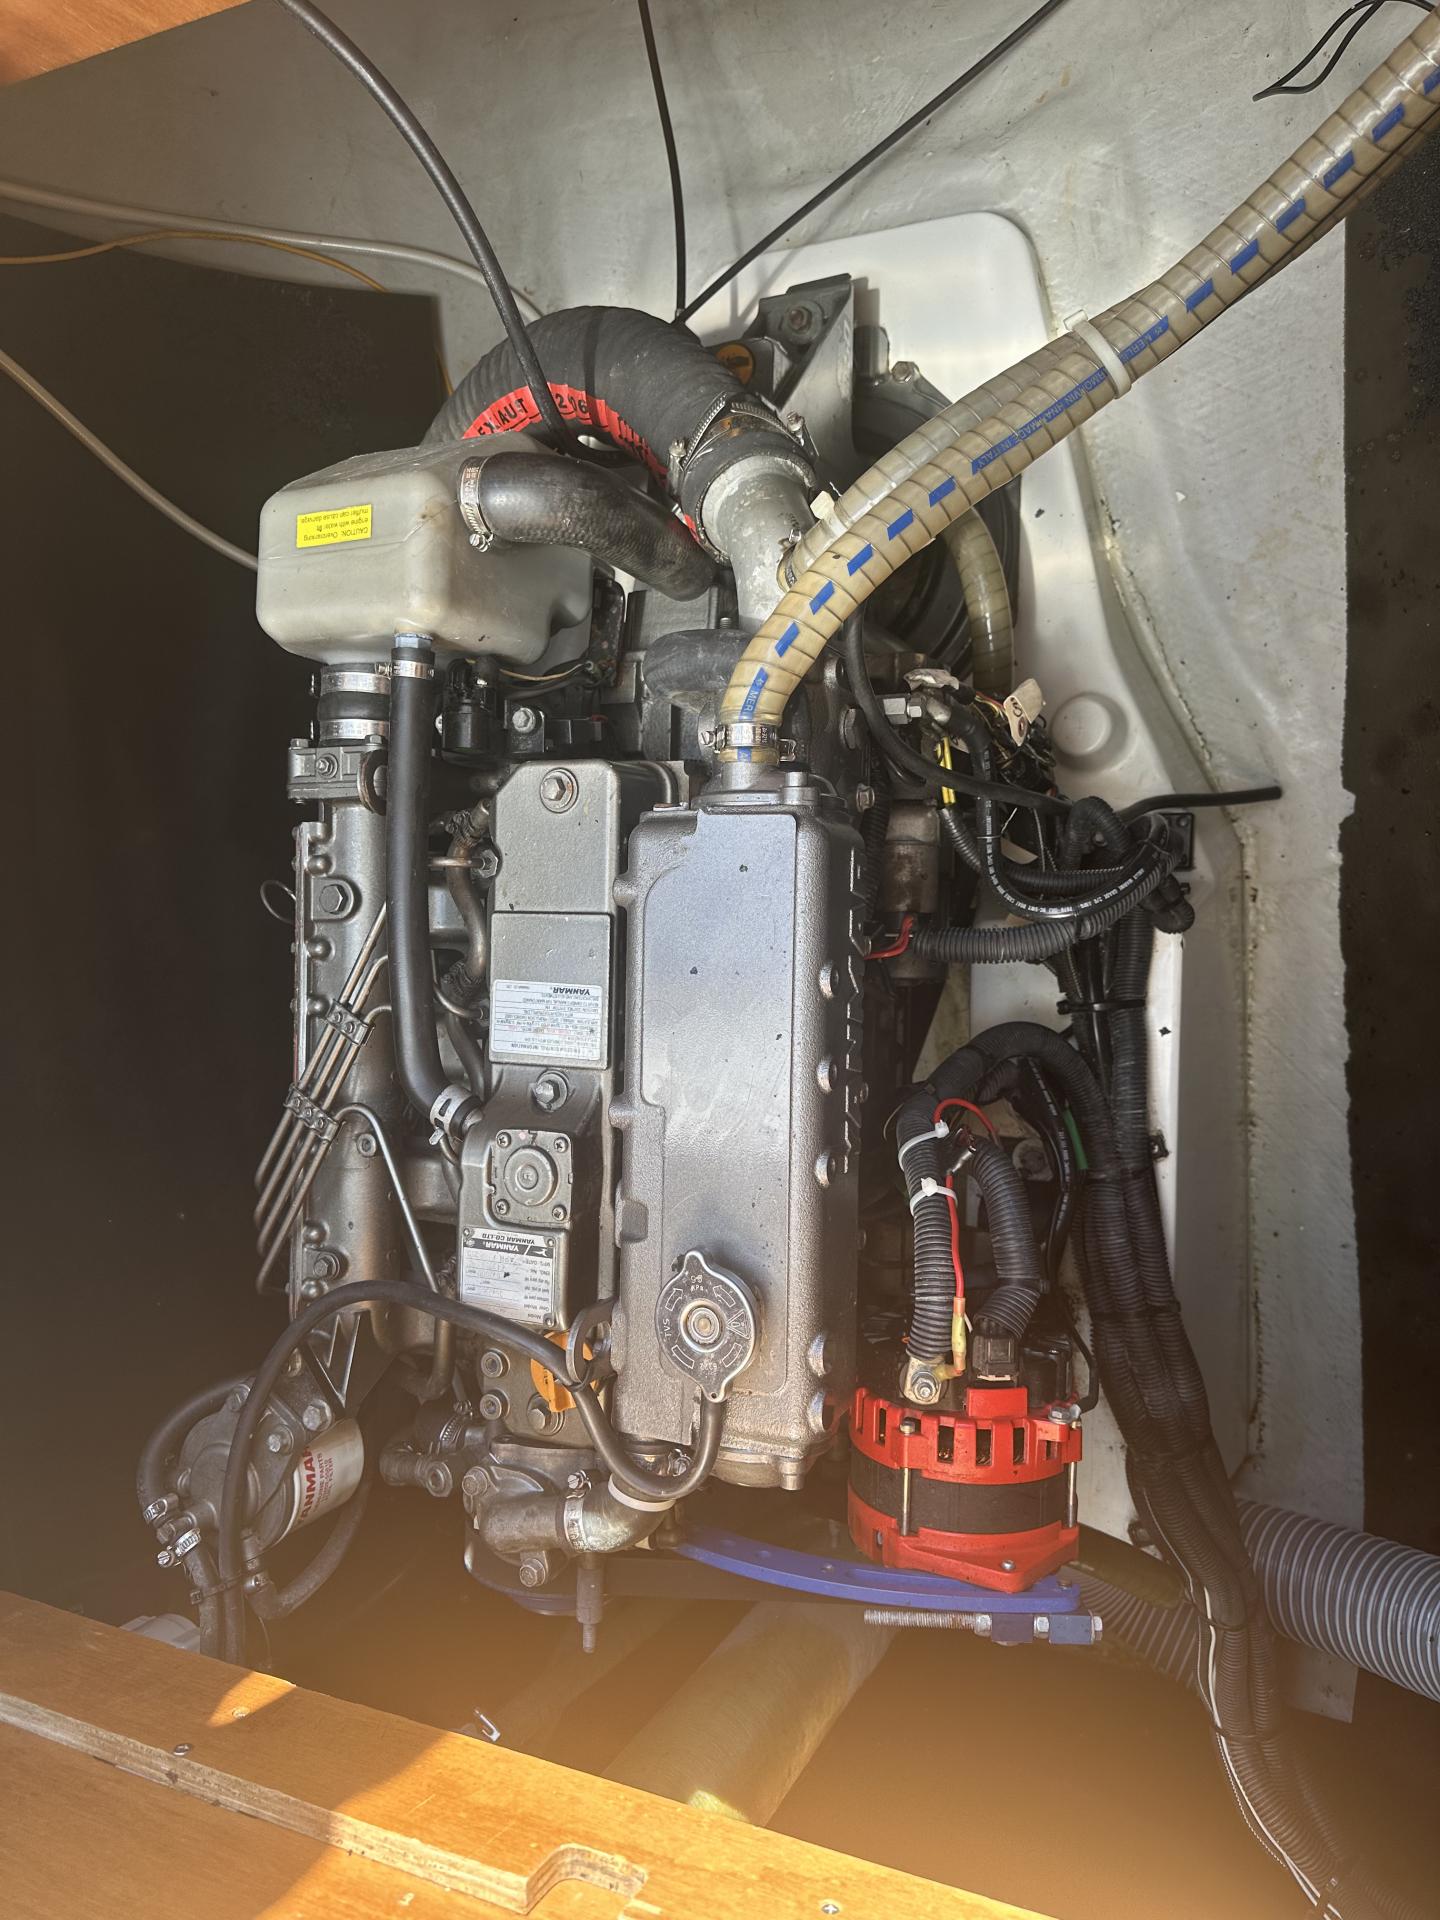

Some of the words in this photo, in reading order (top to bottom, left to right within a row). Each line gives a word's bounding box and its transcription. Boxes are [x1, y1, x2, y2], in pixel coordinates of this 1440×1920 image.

[1001, 437, 1012, 450] IN
[976, 446, 999, 468] ITALY
[350, 508, 369, 517] muffler
[351, 517, 369, 527] engine
[341, 526, 369, 537] CAUTION:
[552, 986, 591, 996] YANMAR
[506, 1236, 535, 1245] YANMAR
[485, 1241, 519, 1252] YANMAR
[663, 1318, 672, 1338] TVS
[317, 1453, 325, 1478] PARTS
